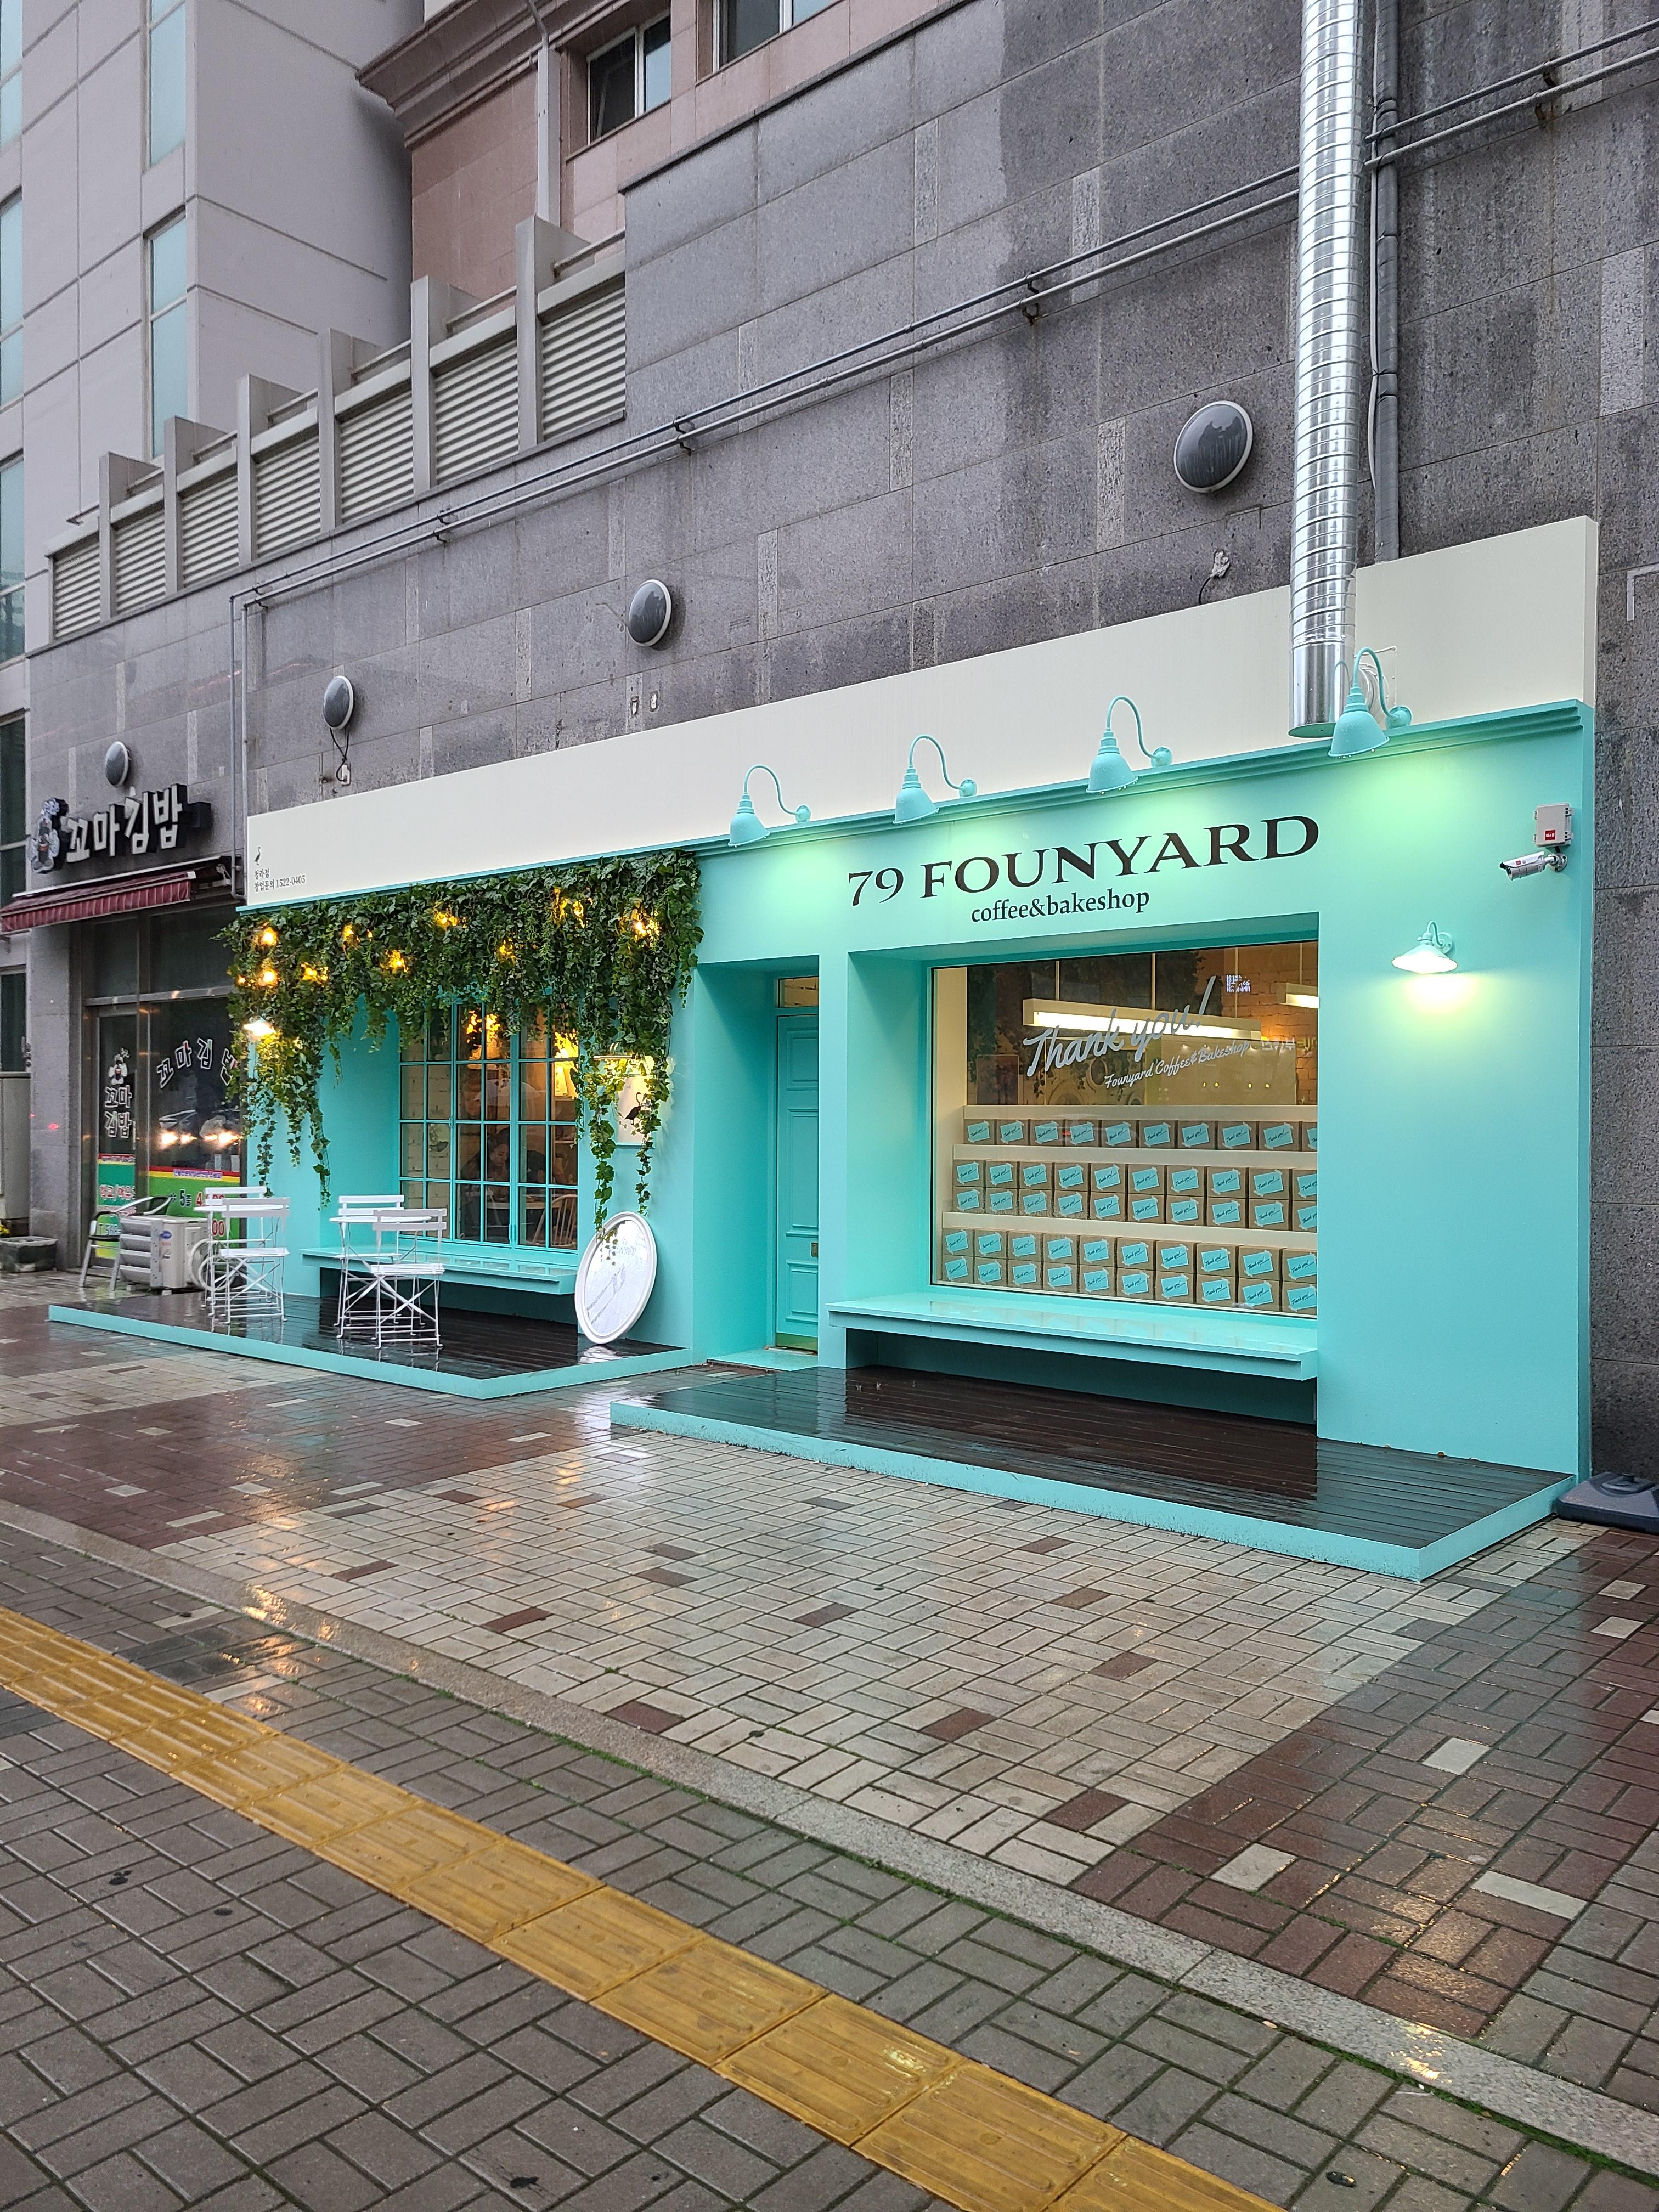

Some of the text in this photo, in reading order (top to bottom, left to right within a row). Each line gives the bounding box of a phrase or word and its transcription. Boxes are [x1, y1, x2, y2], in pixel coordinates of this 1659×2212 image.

[65, 783, 183, 863] 꼬마김밥
[848, 815, 1320, 907] 79 FOUNYARD
[255, 875, 306, 892] 창업문의 1522-0405
[971, 888, 1150, 923] coffee&bakeshop
[1023, 975, 1217, 1077] Thank you!
[1104, 1063, 1154, 1089] Founyard
[104, 1084, 132, 1108] 꼬마
[104, 1110, 132, 1138] 김밥
